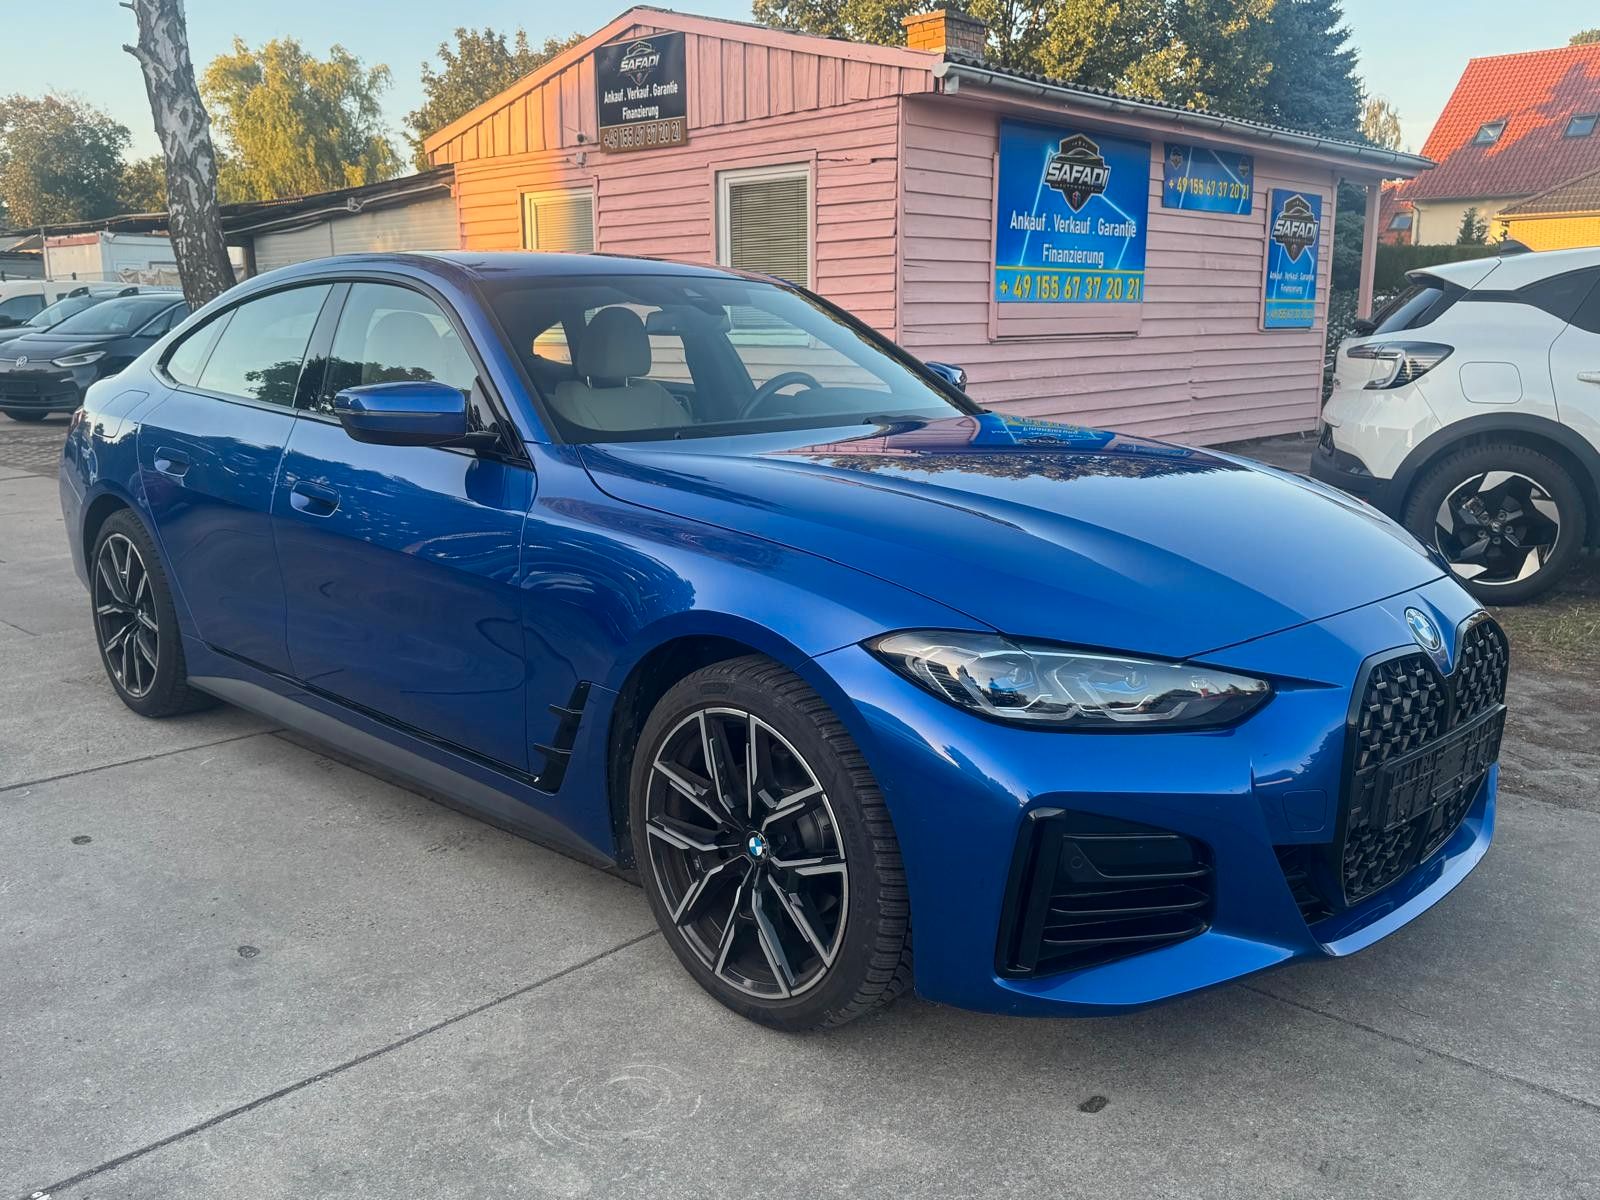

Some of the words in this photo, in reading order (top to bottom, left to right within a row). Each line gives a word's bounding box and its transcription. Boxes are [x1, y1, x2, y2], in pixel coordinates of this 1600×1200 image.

[620, 54, 660, 72] SAFADI
[604, 88, 624, 104] Ankauf
[627, 85, 650, 100] Verkauf
[653, 80, 678, 96] Garantie
[622, 105, 659, 120] Finanzierung
[646, 124, 657, 144] 37
[659, 122, 670, 142] 20
[671, 120, 680, 141] 21
[1046, 162, 1108, 186] SAFADI
[1177, 177, 1188, 192] 49
[1190, 178, 1204, 195] 155
[1206, 180, 1216, 196] 67
[1218, 182, 1228, 197] 37
[1230, 183, 1240, 198] 20
[1242, 184, 1250, 199] 21
[1010, 210, 1046, 231] Ankauf
[1054, 214, 1091, 234] Verkauf
[1098, 218, 1136, 237] Garantie
[1274, 220, 1317, 238] SAFADI
[1042, 244, 1104, 268] Finanzierung
[1014, 274, 1032, 299] 49
[1036, 275, 1060, 299] 155
[1064, 276, 1082, 299] 67
[1085, 276, 1101, 299] 37
[1105, 277, 1122, 299] 20
[1126, 278, 1140, 299] 21
